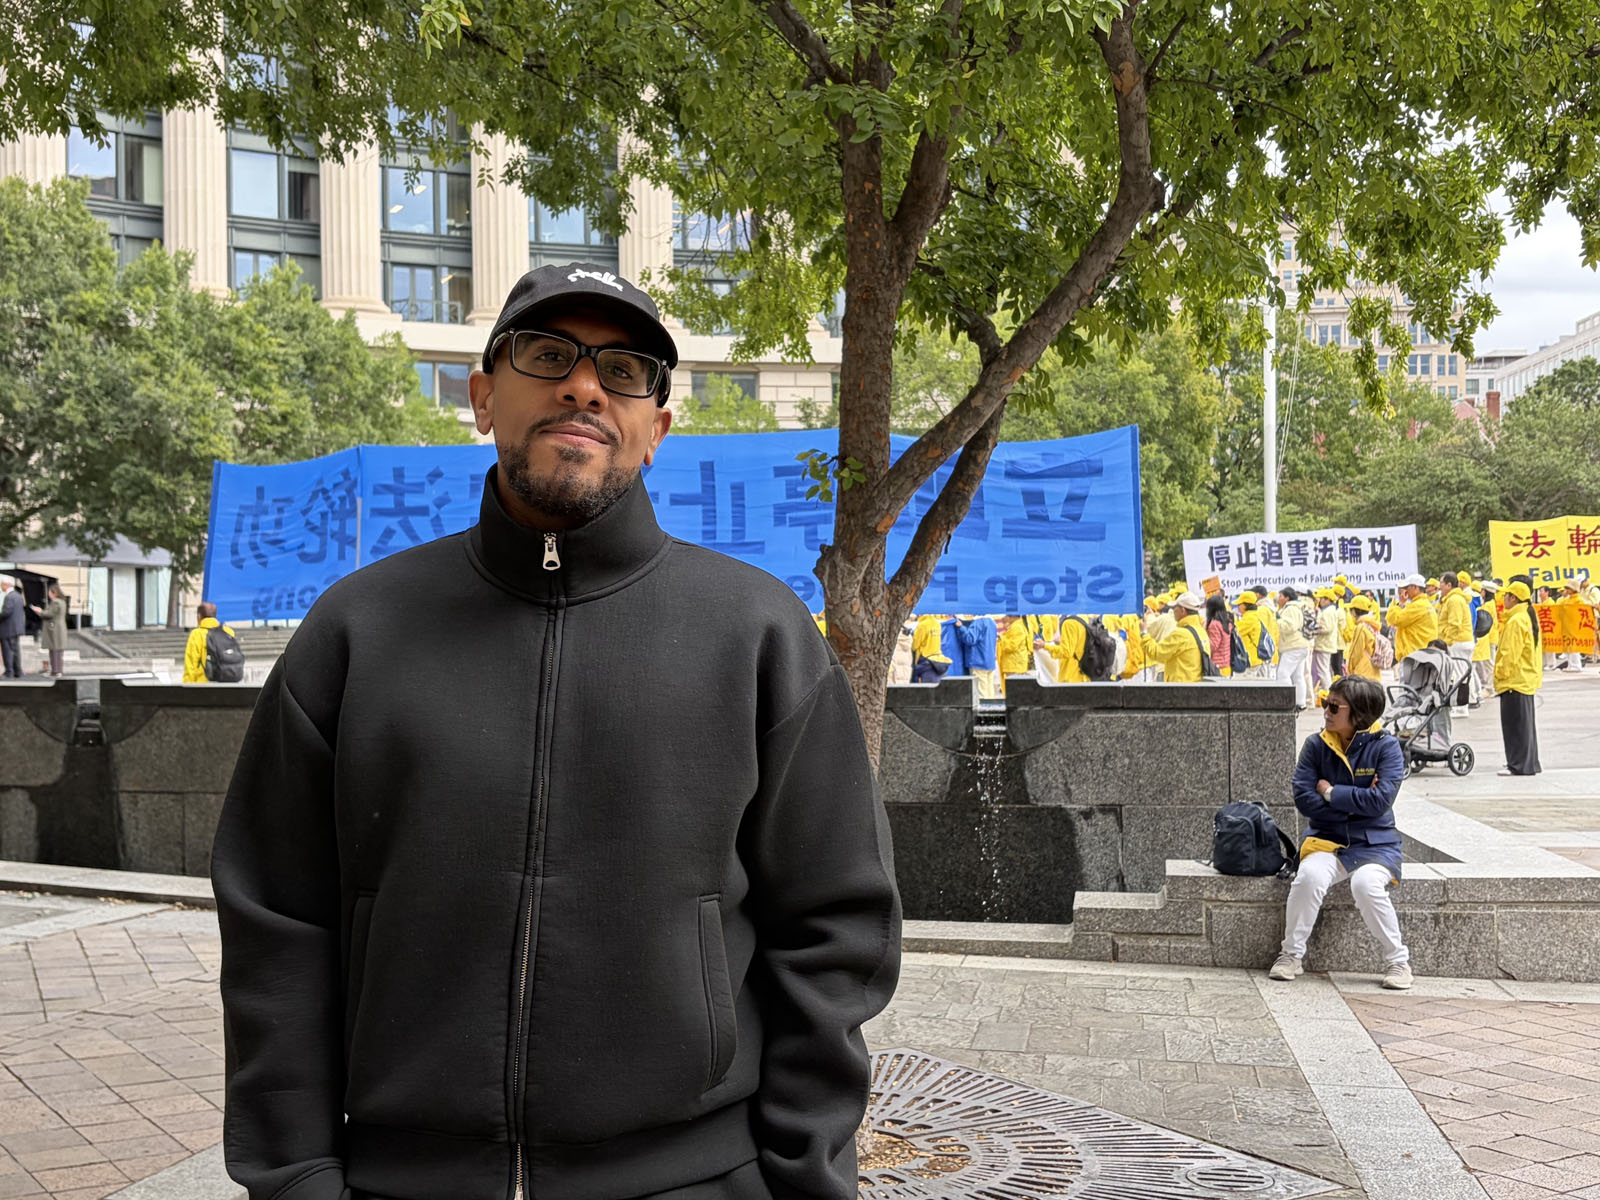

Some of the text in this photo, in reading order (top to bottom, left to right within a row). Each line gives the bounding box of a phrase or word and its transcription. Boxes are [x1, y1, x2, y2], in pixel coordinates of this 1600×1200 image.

[1208, 535, 1392, 572] 停止迫害法輪功
[1221, 579, 1242, 589] Stop
[1244, 575, 1296, 586] Persecution
[1298, 573, 1308, 583] of
[1336, 572, 1361, 584] ong
[1365, 571, 1375, 582] in
[1378, 570, 1406, 581] China
